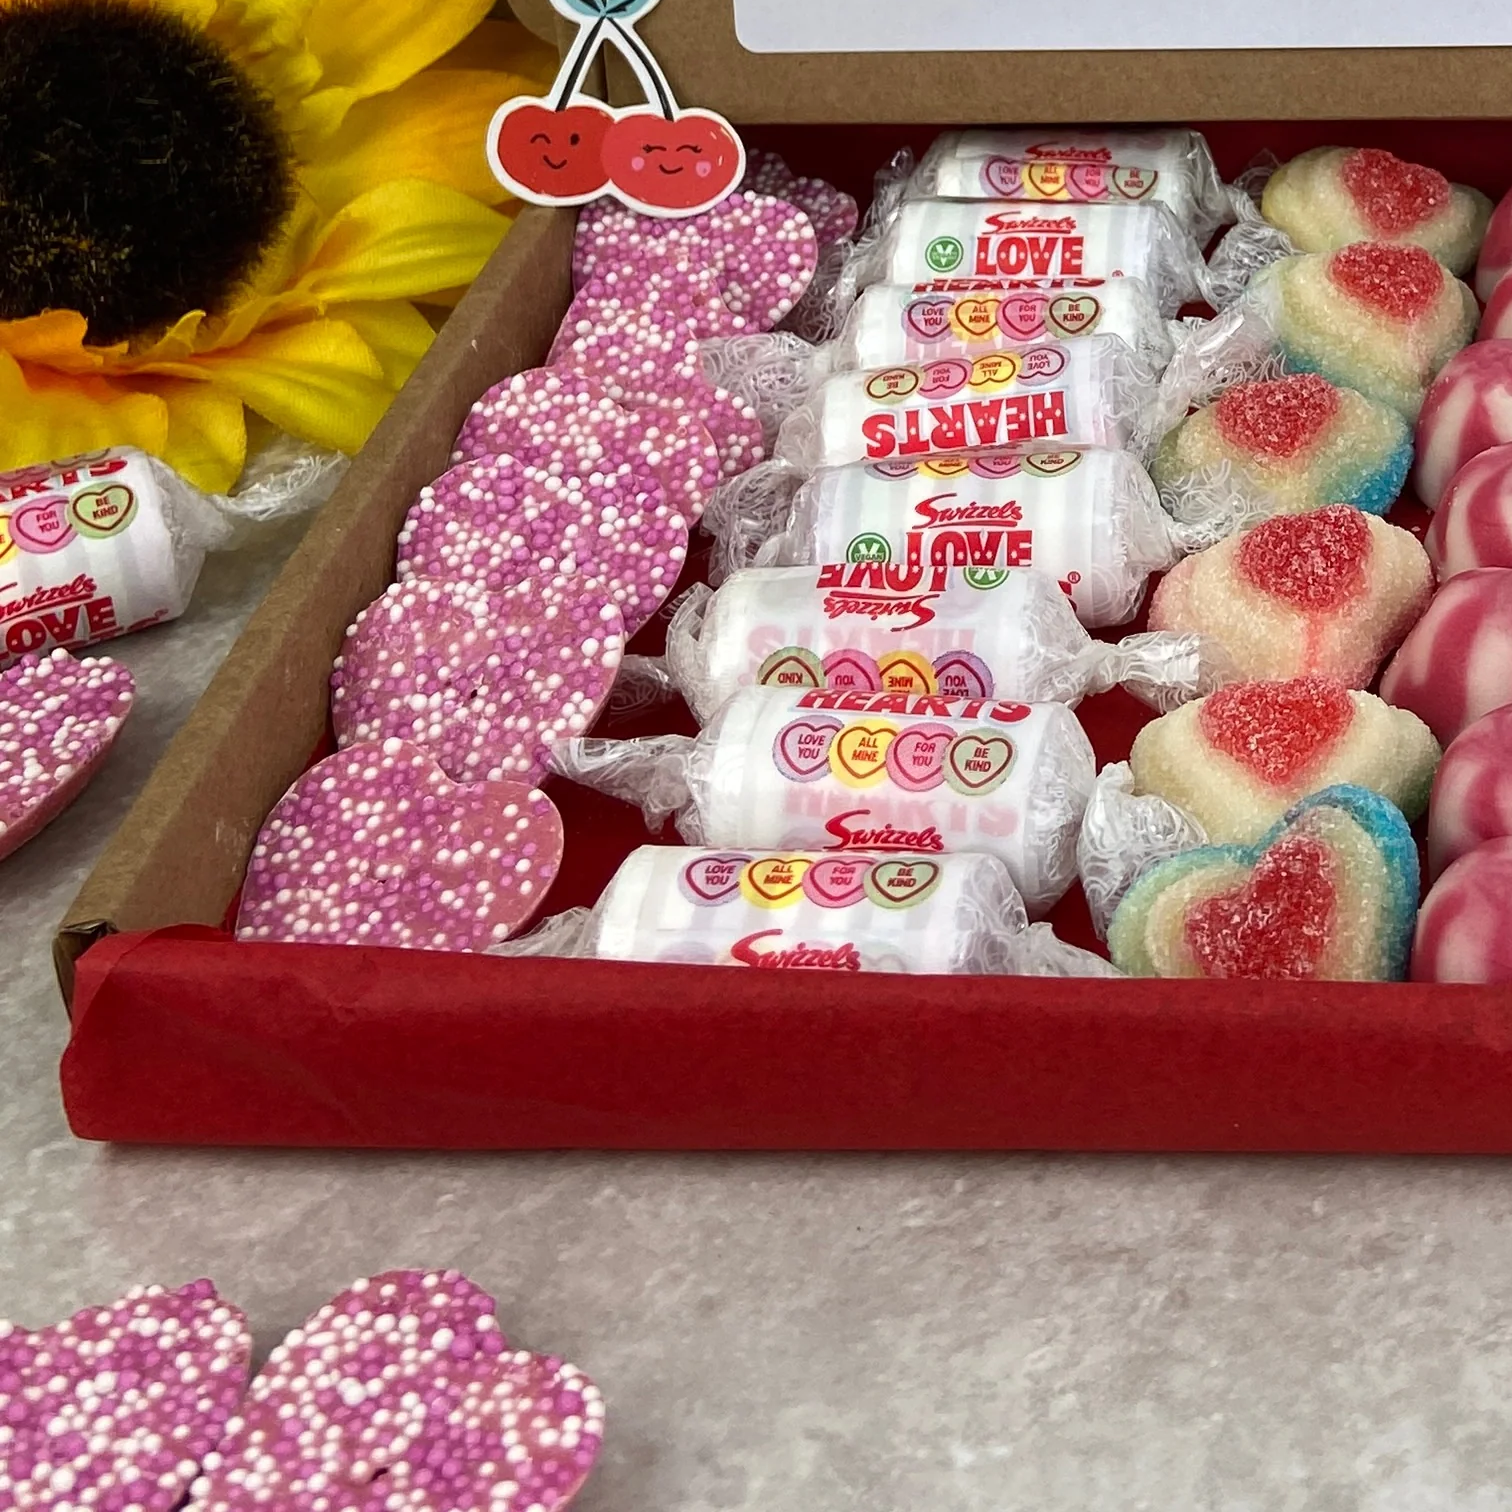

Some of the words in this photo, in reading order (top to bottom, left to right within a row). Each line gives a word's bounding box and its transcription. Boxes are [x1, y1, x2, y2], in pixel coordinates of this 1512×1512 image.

[975, 236, 1084, 275] LOVE
[922, 307, 945, 317] LOVE
[972, 305, 988, 314] ALL
[1019, 304, 1036, 313] FOR
[1068, 303, 1080, 313] BE
[924, 317, 943, 327] YOU
[968, 314, 991, 324] MINE
[1019, 313, 1036, 323] YOU
[1063, 312, 1085, 322] KIND
[861, 391, 1069, 458] HEARTS
[95, 496, 110, 507] BE
[36, 510, 57, 522] FOR
[93, 505, 119, 520] KIND
[912, 492, 1023, 529] Swizzels
[39, 521, 60, 533] YOU
[0, 573, 97, 623] wizzels
[823, 590, 940, 632] Swizzels
[777, 672, 803, 684] KIND
[835, 675, 856, 686] YOU
[888, 676, 914, 688] MINE
[945, 675, 967, 688] YOU
[796, 689, 1032, 723] HEARTS
[798, 734, 825, 746] LOVE
[858, 737, 879, 749] ALL
[799, 747, 820, 759] YOU
[914, 742, 936, 754] FOR
[974, 747, 989, 759] BE
[852, 749, 879, 763] MINE
[912, 755, 933, 767] YOU
[964, 760, 992, 773] KIND
[823, 808, 945, 853] Swizzels
[705, 864, 737, 875] LOVE
[771, 864, 793, 874] ALL
[832, 866, 856, 876] FOR
[897, 867, 914, 877] BE
[705, 875, 731, 886] YOU
[763, 874, 794, 885] MINE
[830, 875, 854, 886] YOU
[887, 877, 917, 888] KIND
[730, 928, 862, 971] Swizzels
